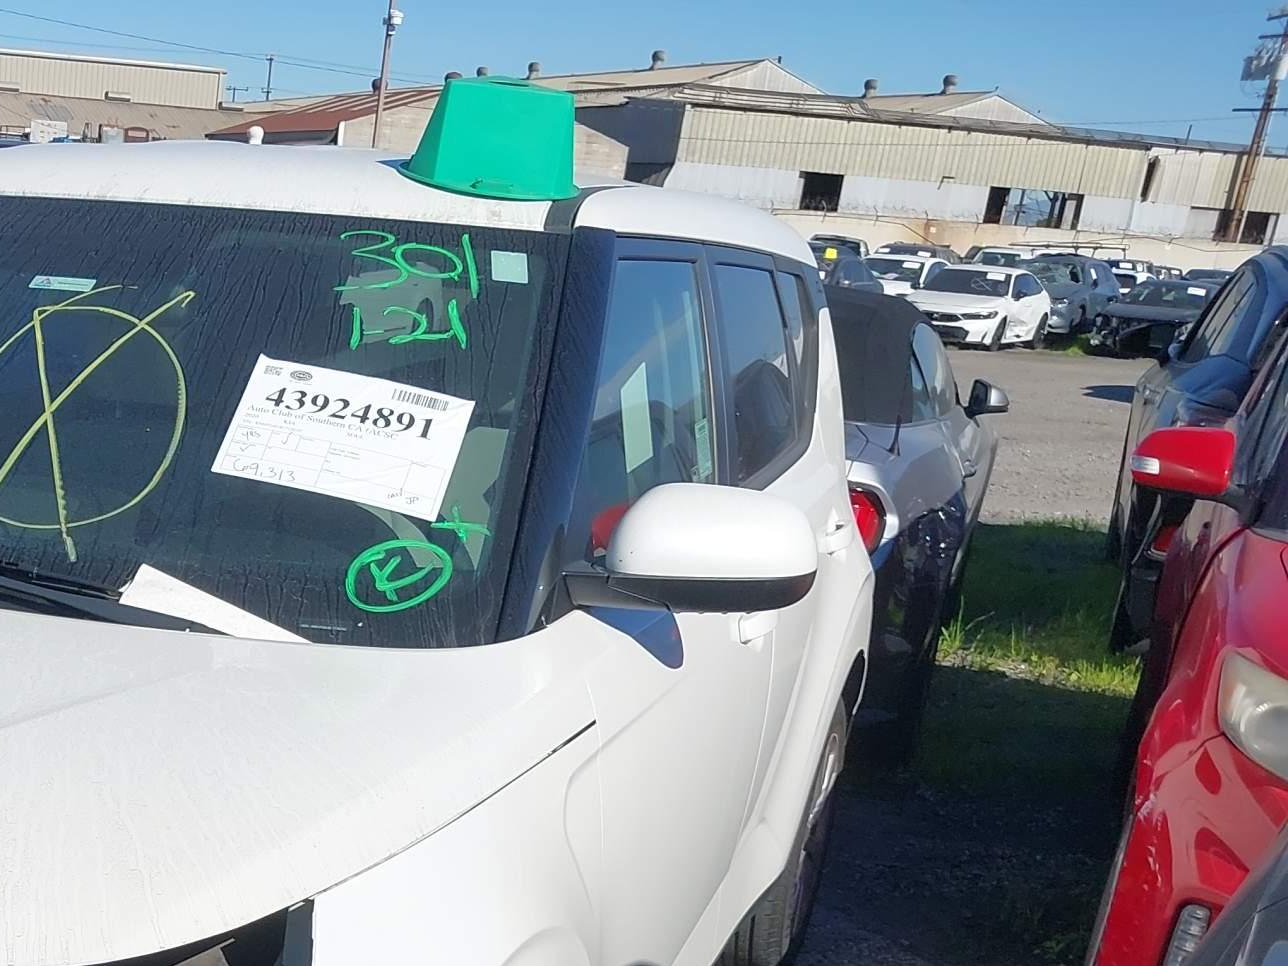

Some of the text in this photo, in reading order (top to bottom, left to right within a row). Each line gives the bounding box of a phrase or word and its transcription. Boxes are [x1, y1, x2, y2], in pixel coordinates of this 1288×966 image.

[333, 230, 480, 299] 301
[247, 404, 270, 414] Auto
[271, 408, 293, 418] Club
[306, 415, 346, 430] Southern
[348, 423, 363, 433] CA
[265, 387, 434, 441] 43924891
